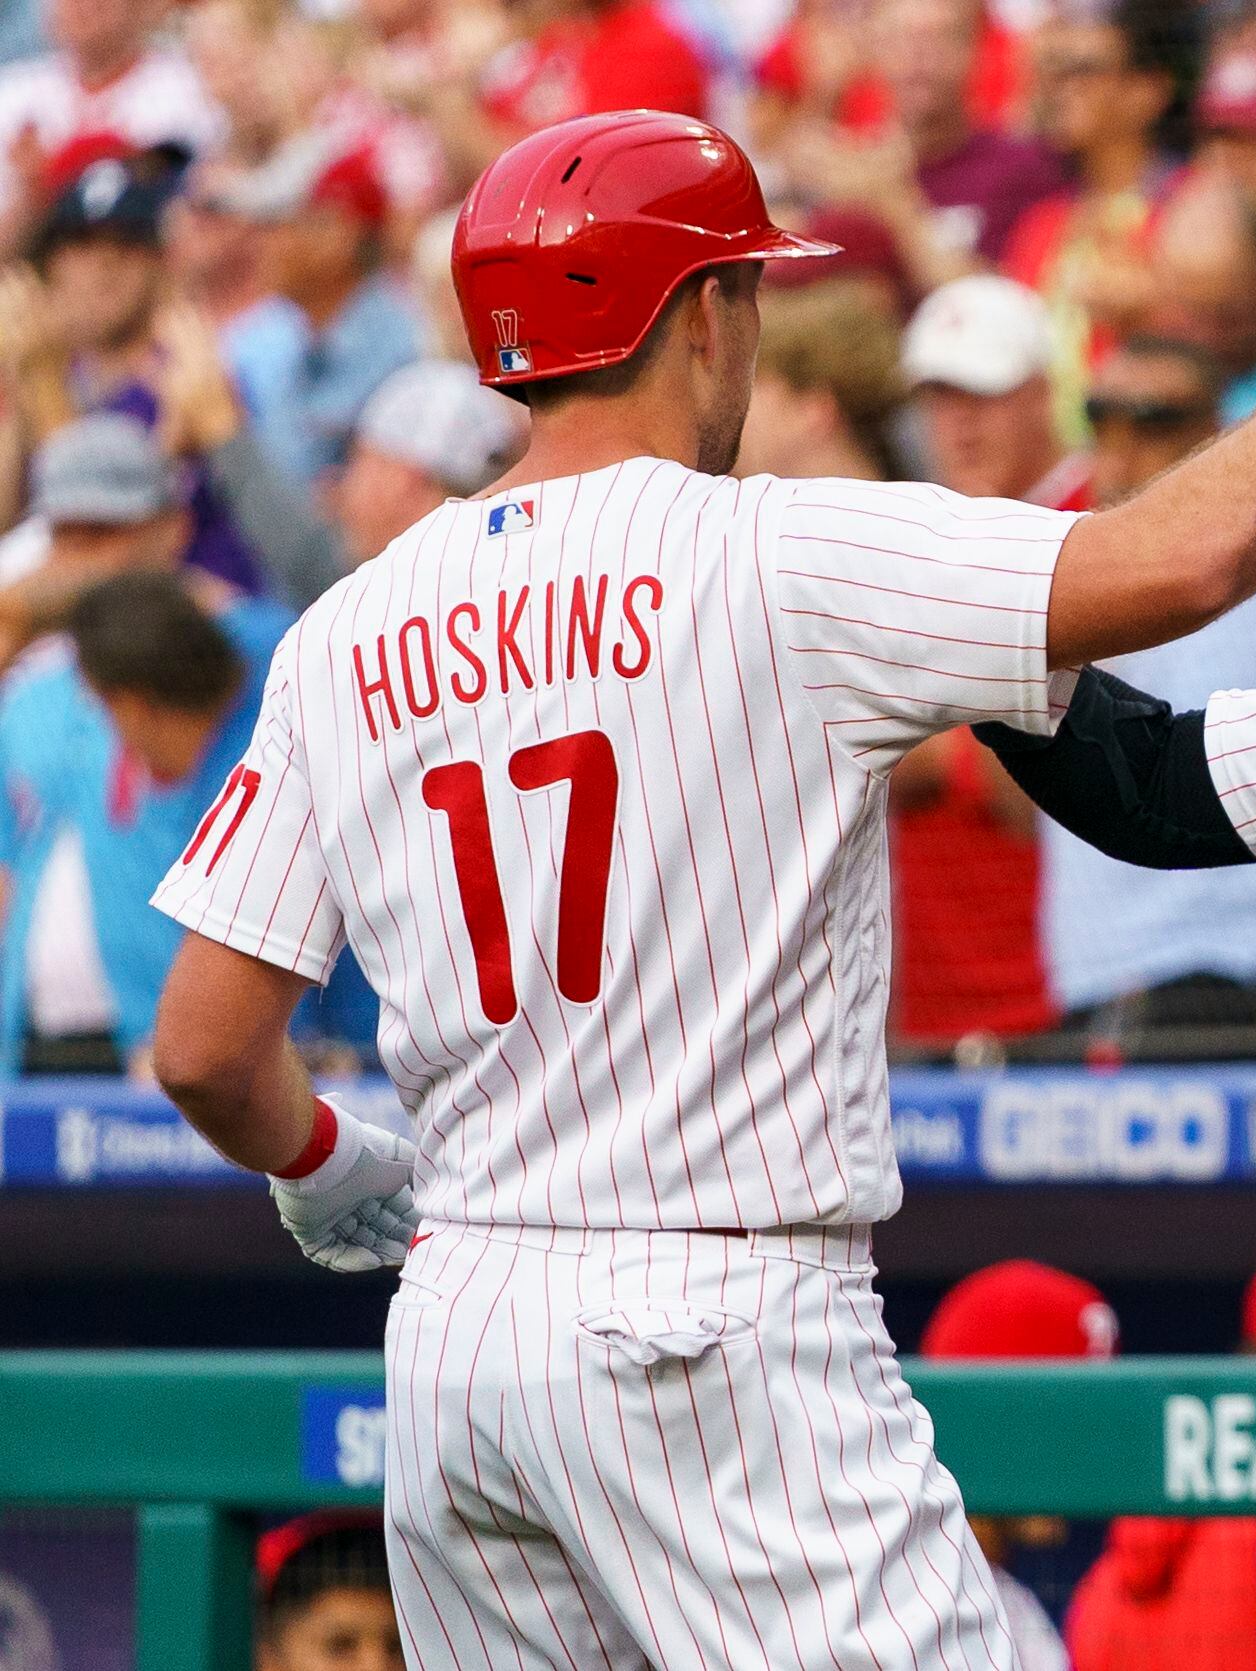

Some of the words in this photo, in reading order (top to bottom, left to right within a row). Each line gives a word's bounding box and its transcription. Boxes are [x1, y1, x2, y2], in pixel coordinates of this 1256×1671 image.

[491, 309, 518, 347] 17
[352, 573, 664, 742] HOSKINS
[421, 729, 619, 1025] 17
[979, 1080, 1229, 1182] GEICO
